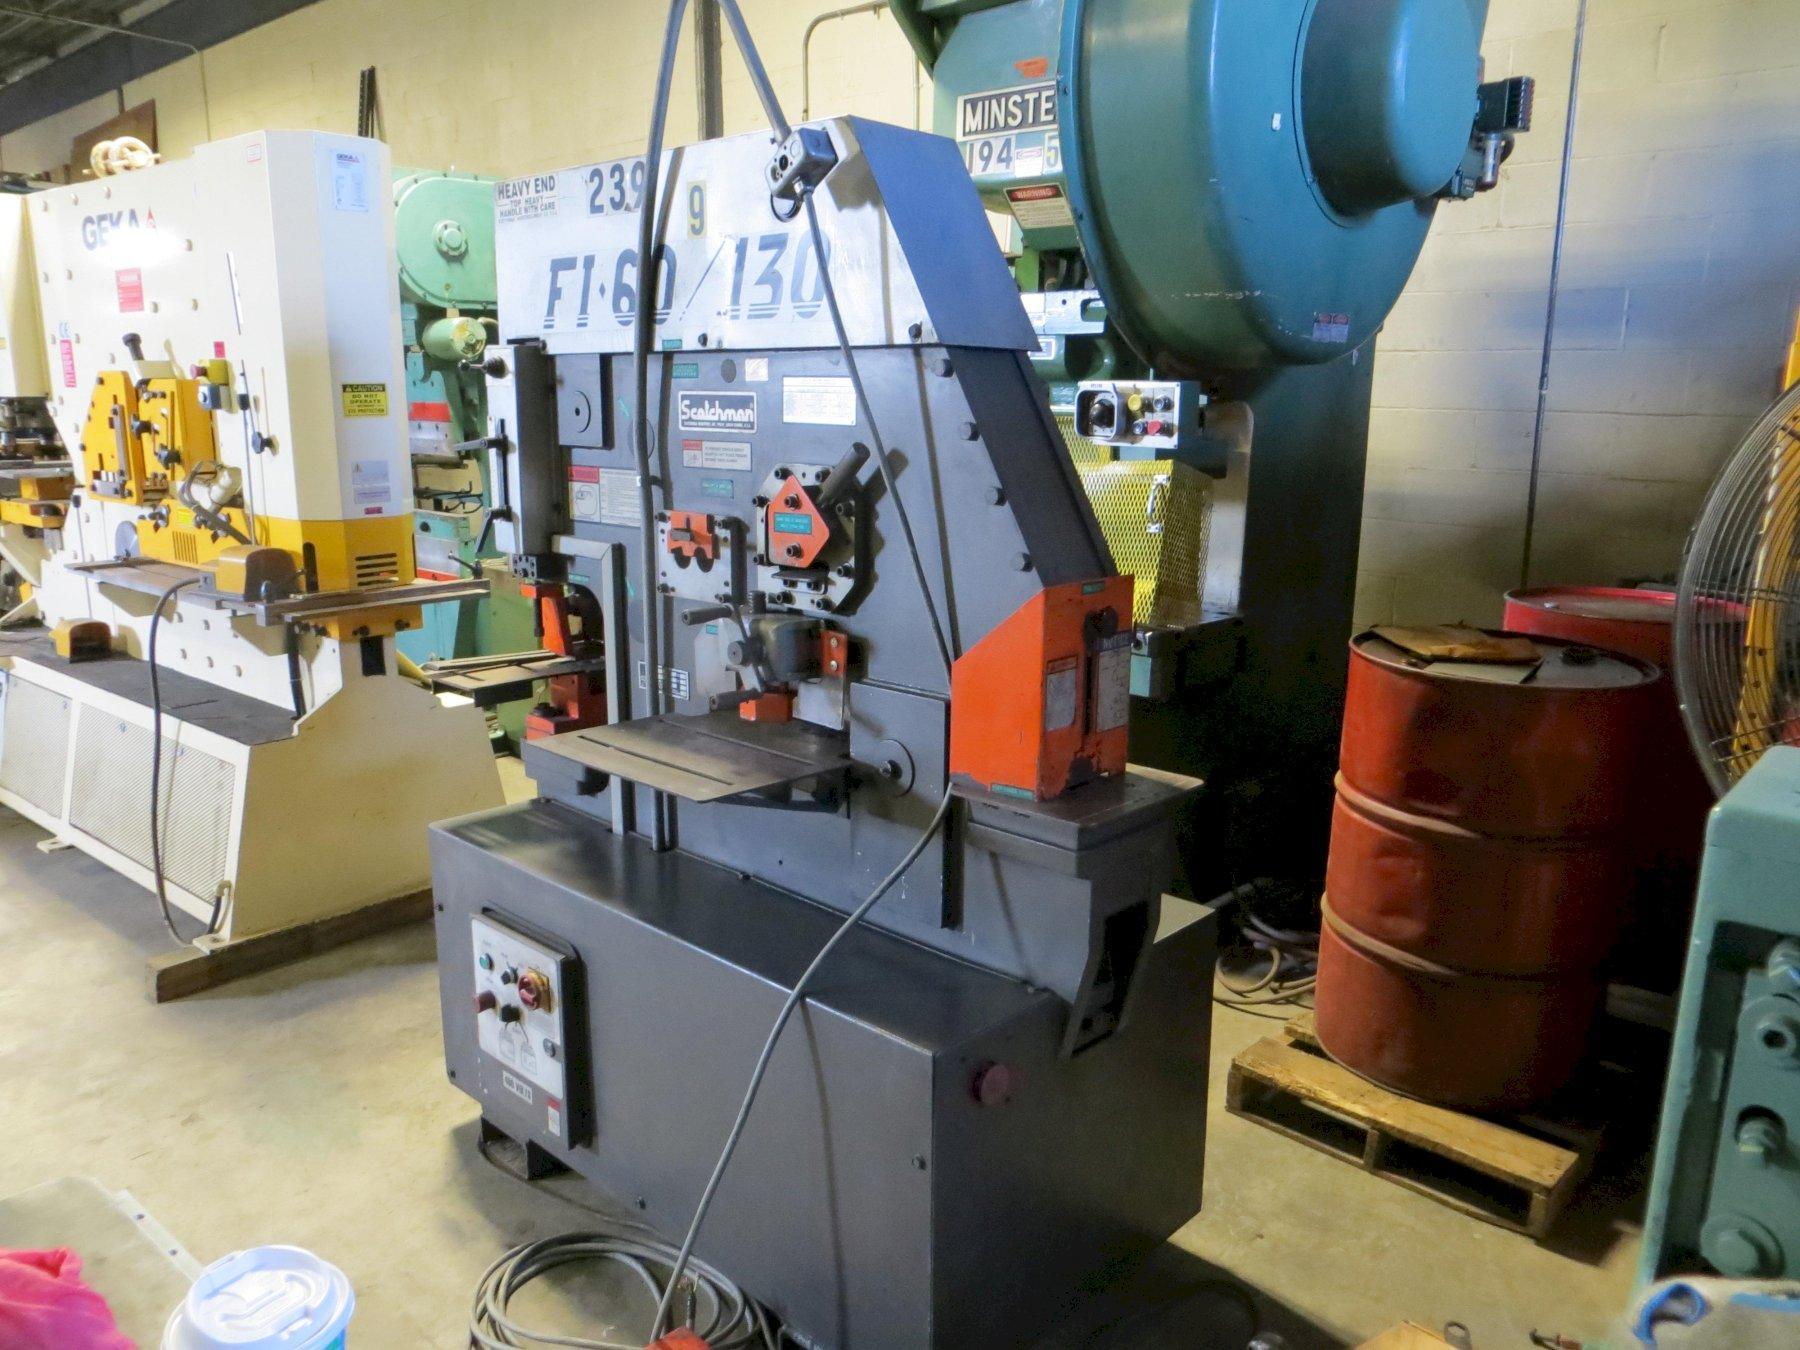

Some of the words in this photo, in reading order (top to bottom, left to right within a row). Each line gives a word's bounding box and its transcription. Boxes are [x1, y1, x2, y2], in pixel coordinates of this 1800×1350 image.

[965, 89, 1056, 133] MINSTE
[498, 179, 531, 200] HEAVY
[534, 174, 556, 194] END
[590, 160, 645, 214] 239
[1016, 188, 1052, 199] WARNING
[499, 207, 522, 218] HANDLE
[523, 204, 538, 214] WITH
[539, 201, 556, 212] CARE
[510, 199, 522, 208] TOP
[524, 196, 543, 205] HEAVY
[689, 185, 704, 235] 9
